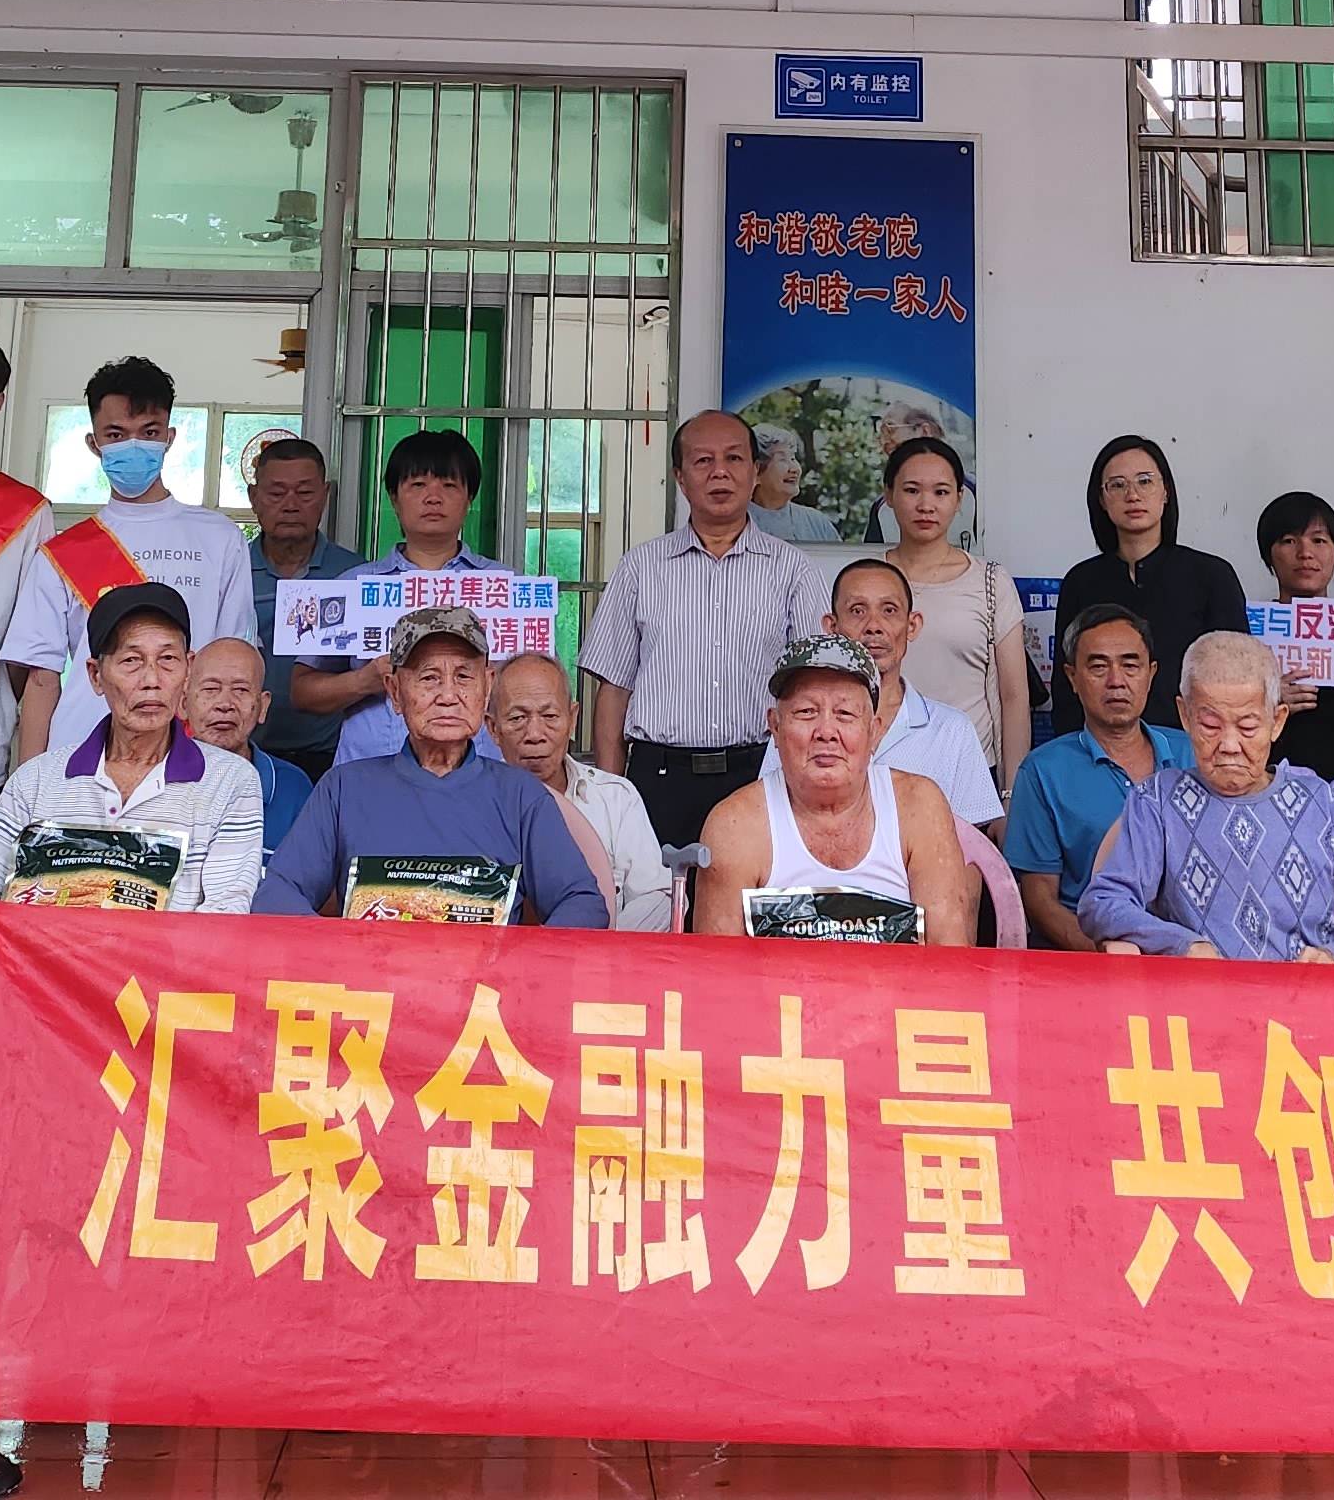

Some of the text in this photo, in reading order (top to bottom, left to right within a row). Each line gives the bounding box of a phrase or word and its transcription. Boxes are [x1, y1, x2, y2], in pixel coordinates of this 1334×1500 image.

[830, 72, 911, 93] 内有监控
[853, 94, 889, 105] TOILET
[735, 210, 922, 260] 和谐敬老院
[779, 270, 967, 323] 和睦一家人
[132, 549, 202, 562] SOMEONE
[174, 575, 201, 588] ARE
[361, 575, 554, 609] 面对非法集资诱惑
[103, 857, 138, 871] CEREAL
[436, 872, 472, 887] CEREAL
[782, 915, 887, 936] GOLDROAST
[78, 974, 1026, 1297] 汇聚金融力量
